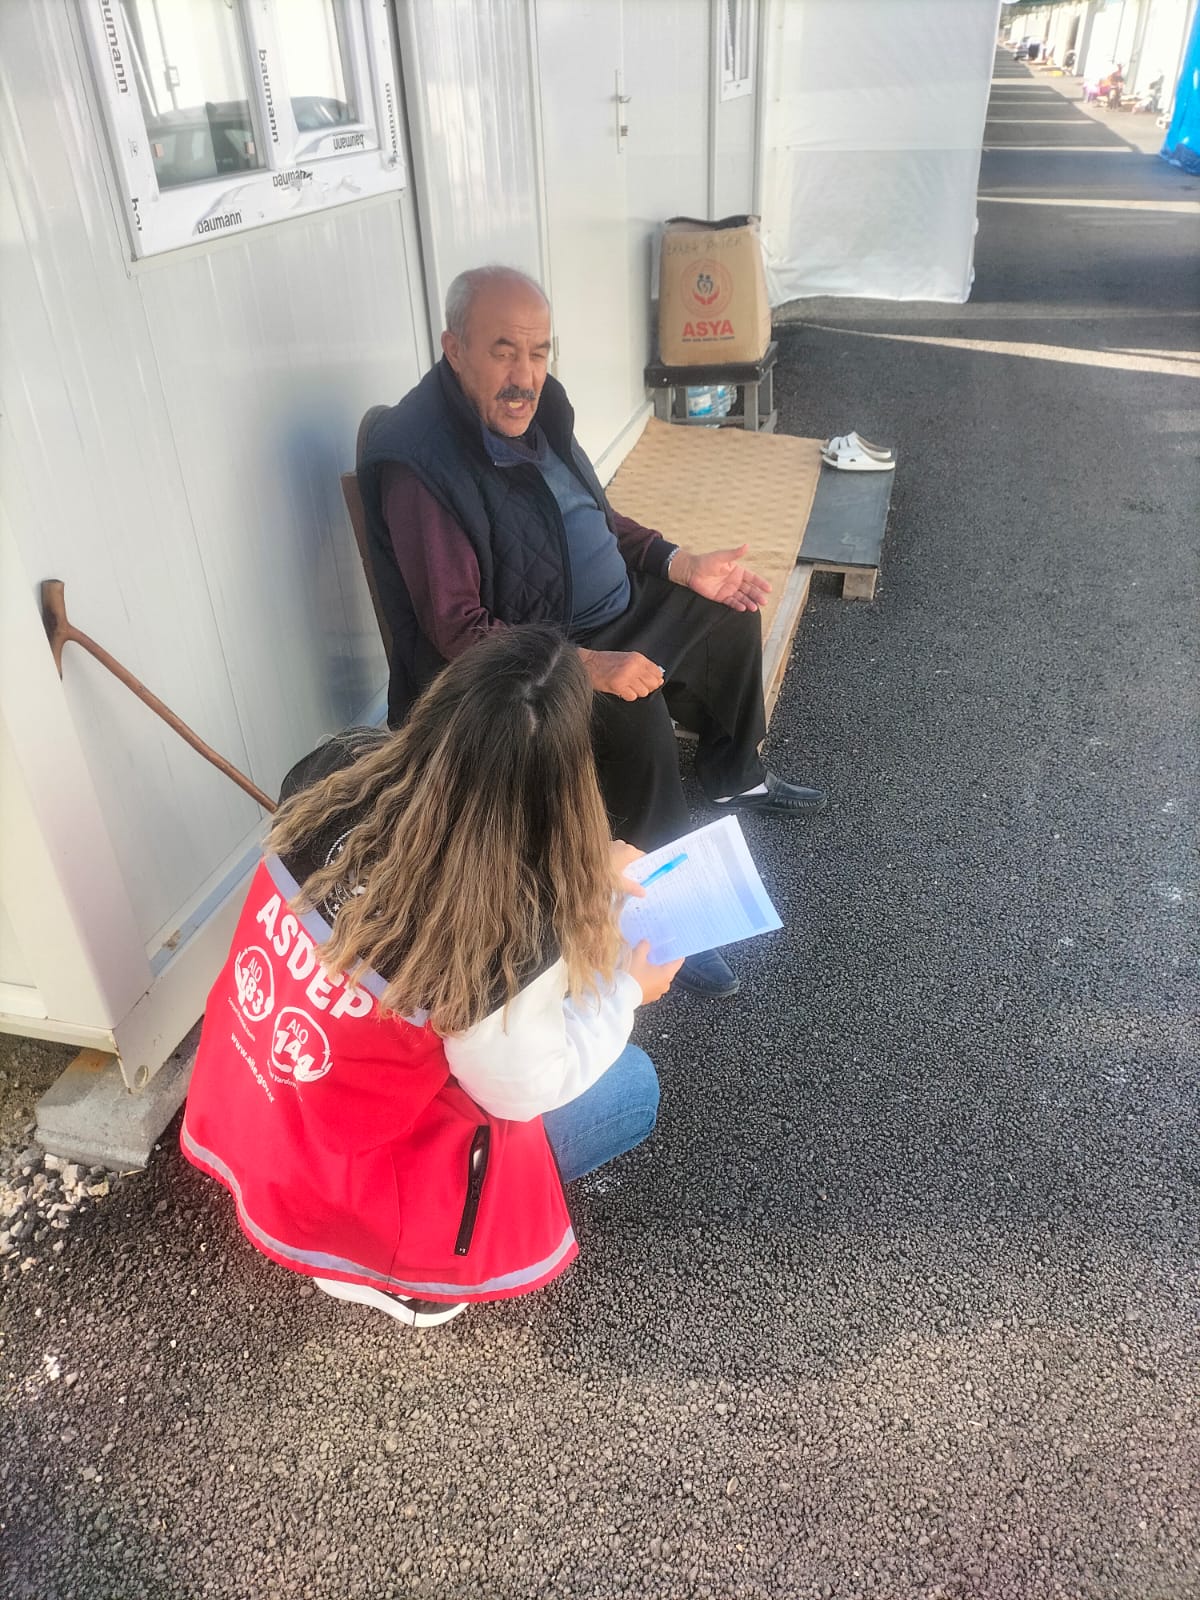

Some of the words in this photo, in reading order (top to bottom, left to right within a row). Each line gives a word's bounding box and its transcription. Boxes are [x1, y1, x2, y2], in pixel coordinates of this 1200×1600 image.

[257, 48, 280, 144] baumann
[682, 320, 734, 336] ASYA
[247, 957, 263, 982] ALO
[256, 893, 374, 1020] ASDEP
[241, 967, 264, 1015] 183
[274, 1030, 316, 1075] 144
[286, 1018, 309, 1045] ALO
